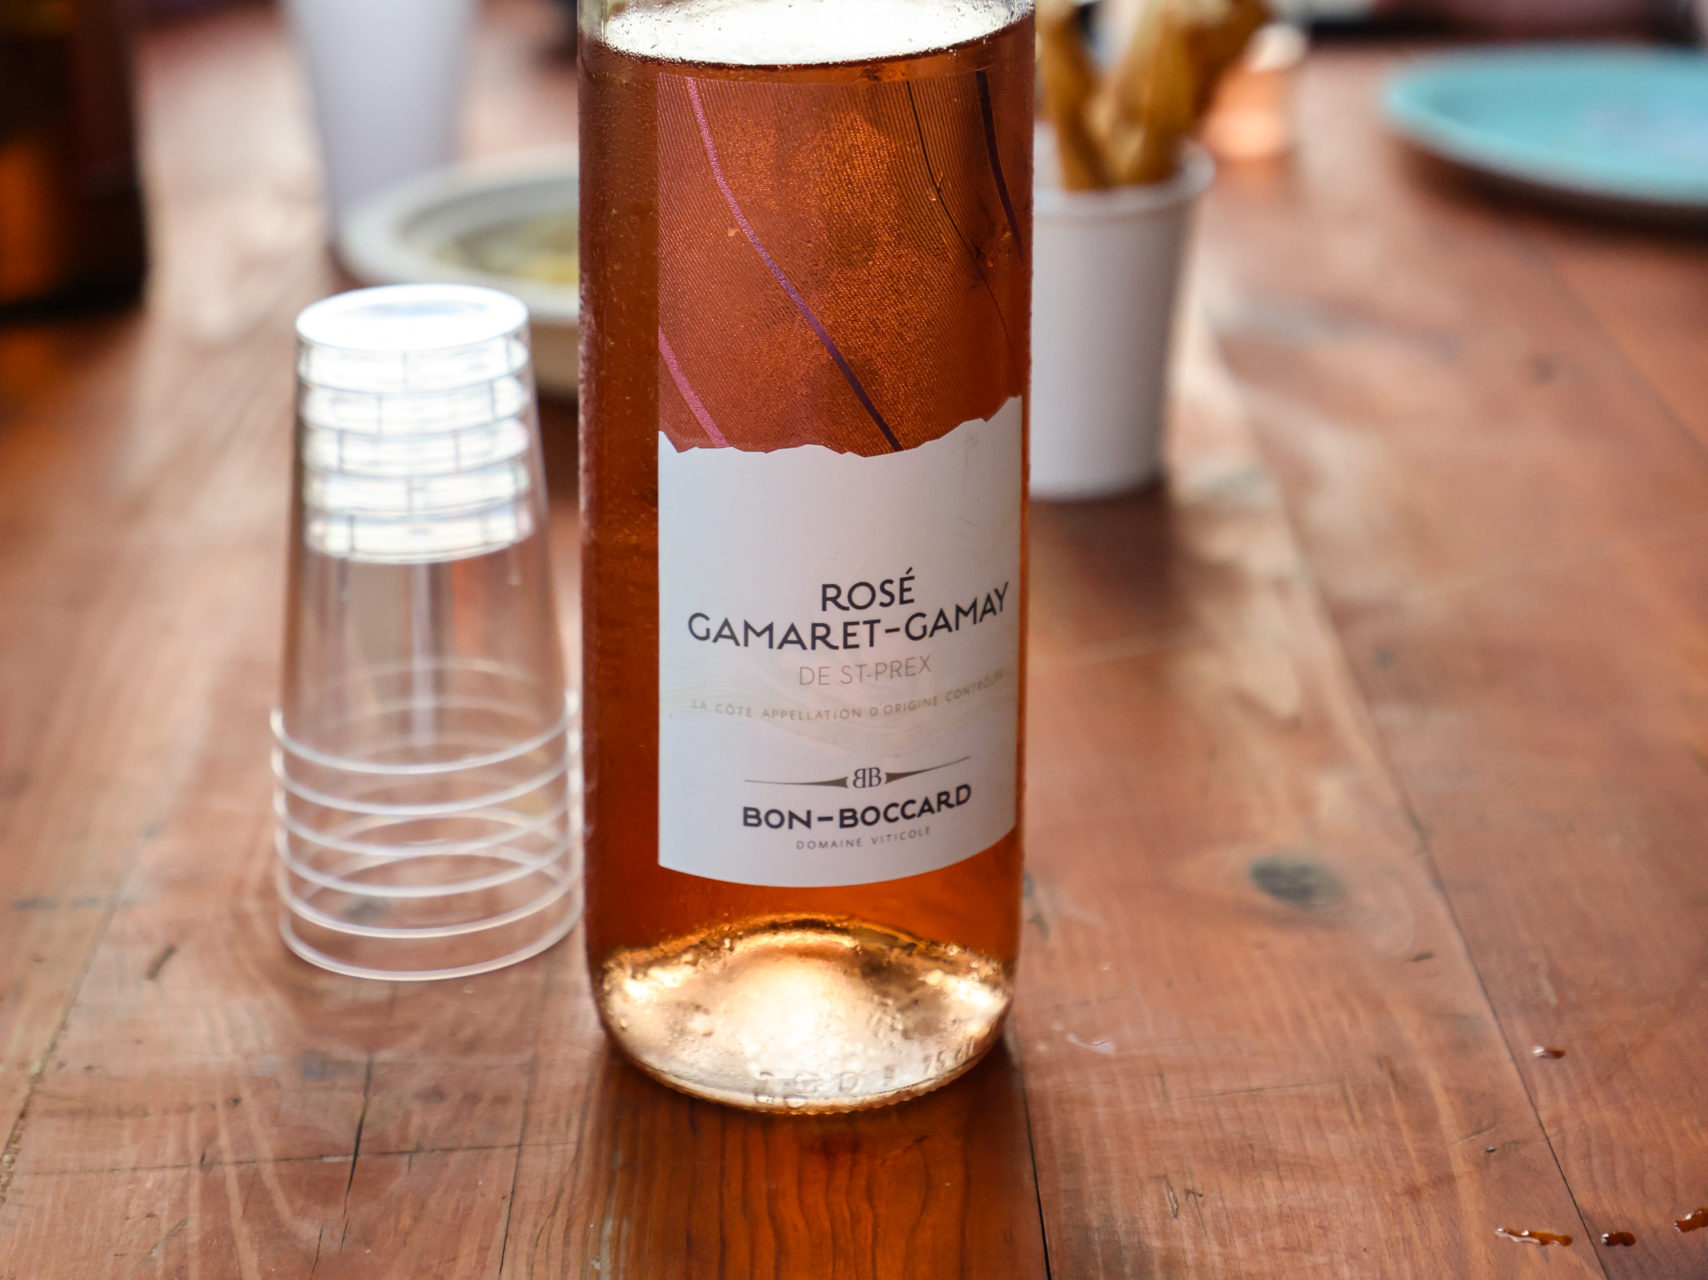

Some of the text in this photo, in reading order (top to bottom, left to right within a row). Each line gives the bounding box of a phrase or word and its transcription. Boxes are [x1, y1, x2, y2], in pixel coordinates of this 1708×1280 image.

[820, 567, 916, 612] ROSÉ
[688, 581, 1009, 651] GAMARET-GAMAY
[799, 654, 932, 686] DE ST-PREX
[692, 699, 707, 710] LA
[715, 702, 752, 718] CÔTE
[761, 708, 862, 721] APPELLATION
[742, 783, 973, 830] BON-BOCCARD
[796, 826, 932, 850] DOMAINE VITICOLE
